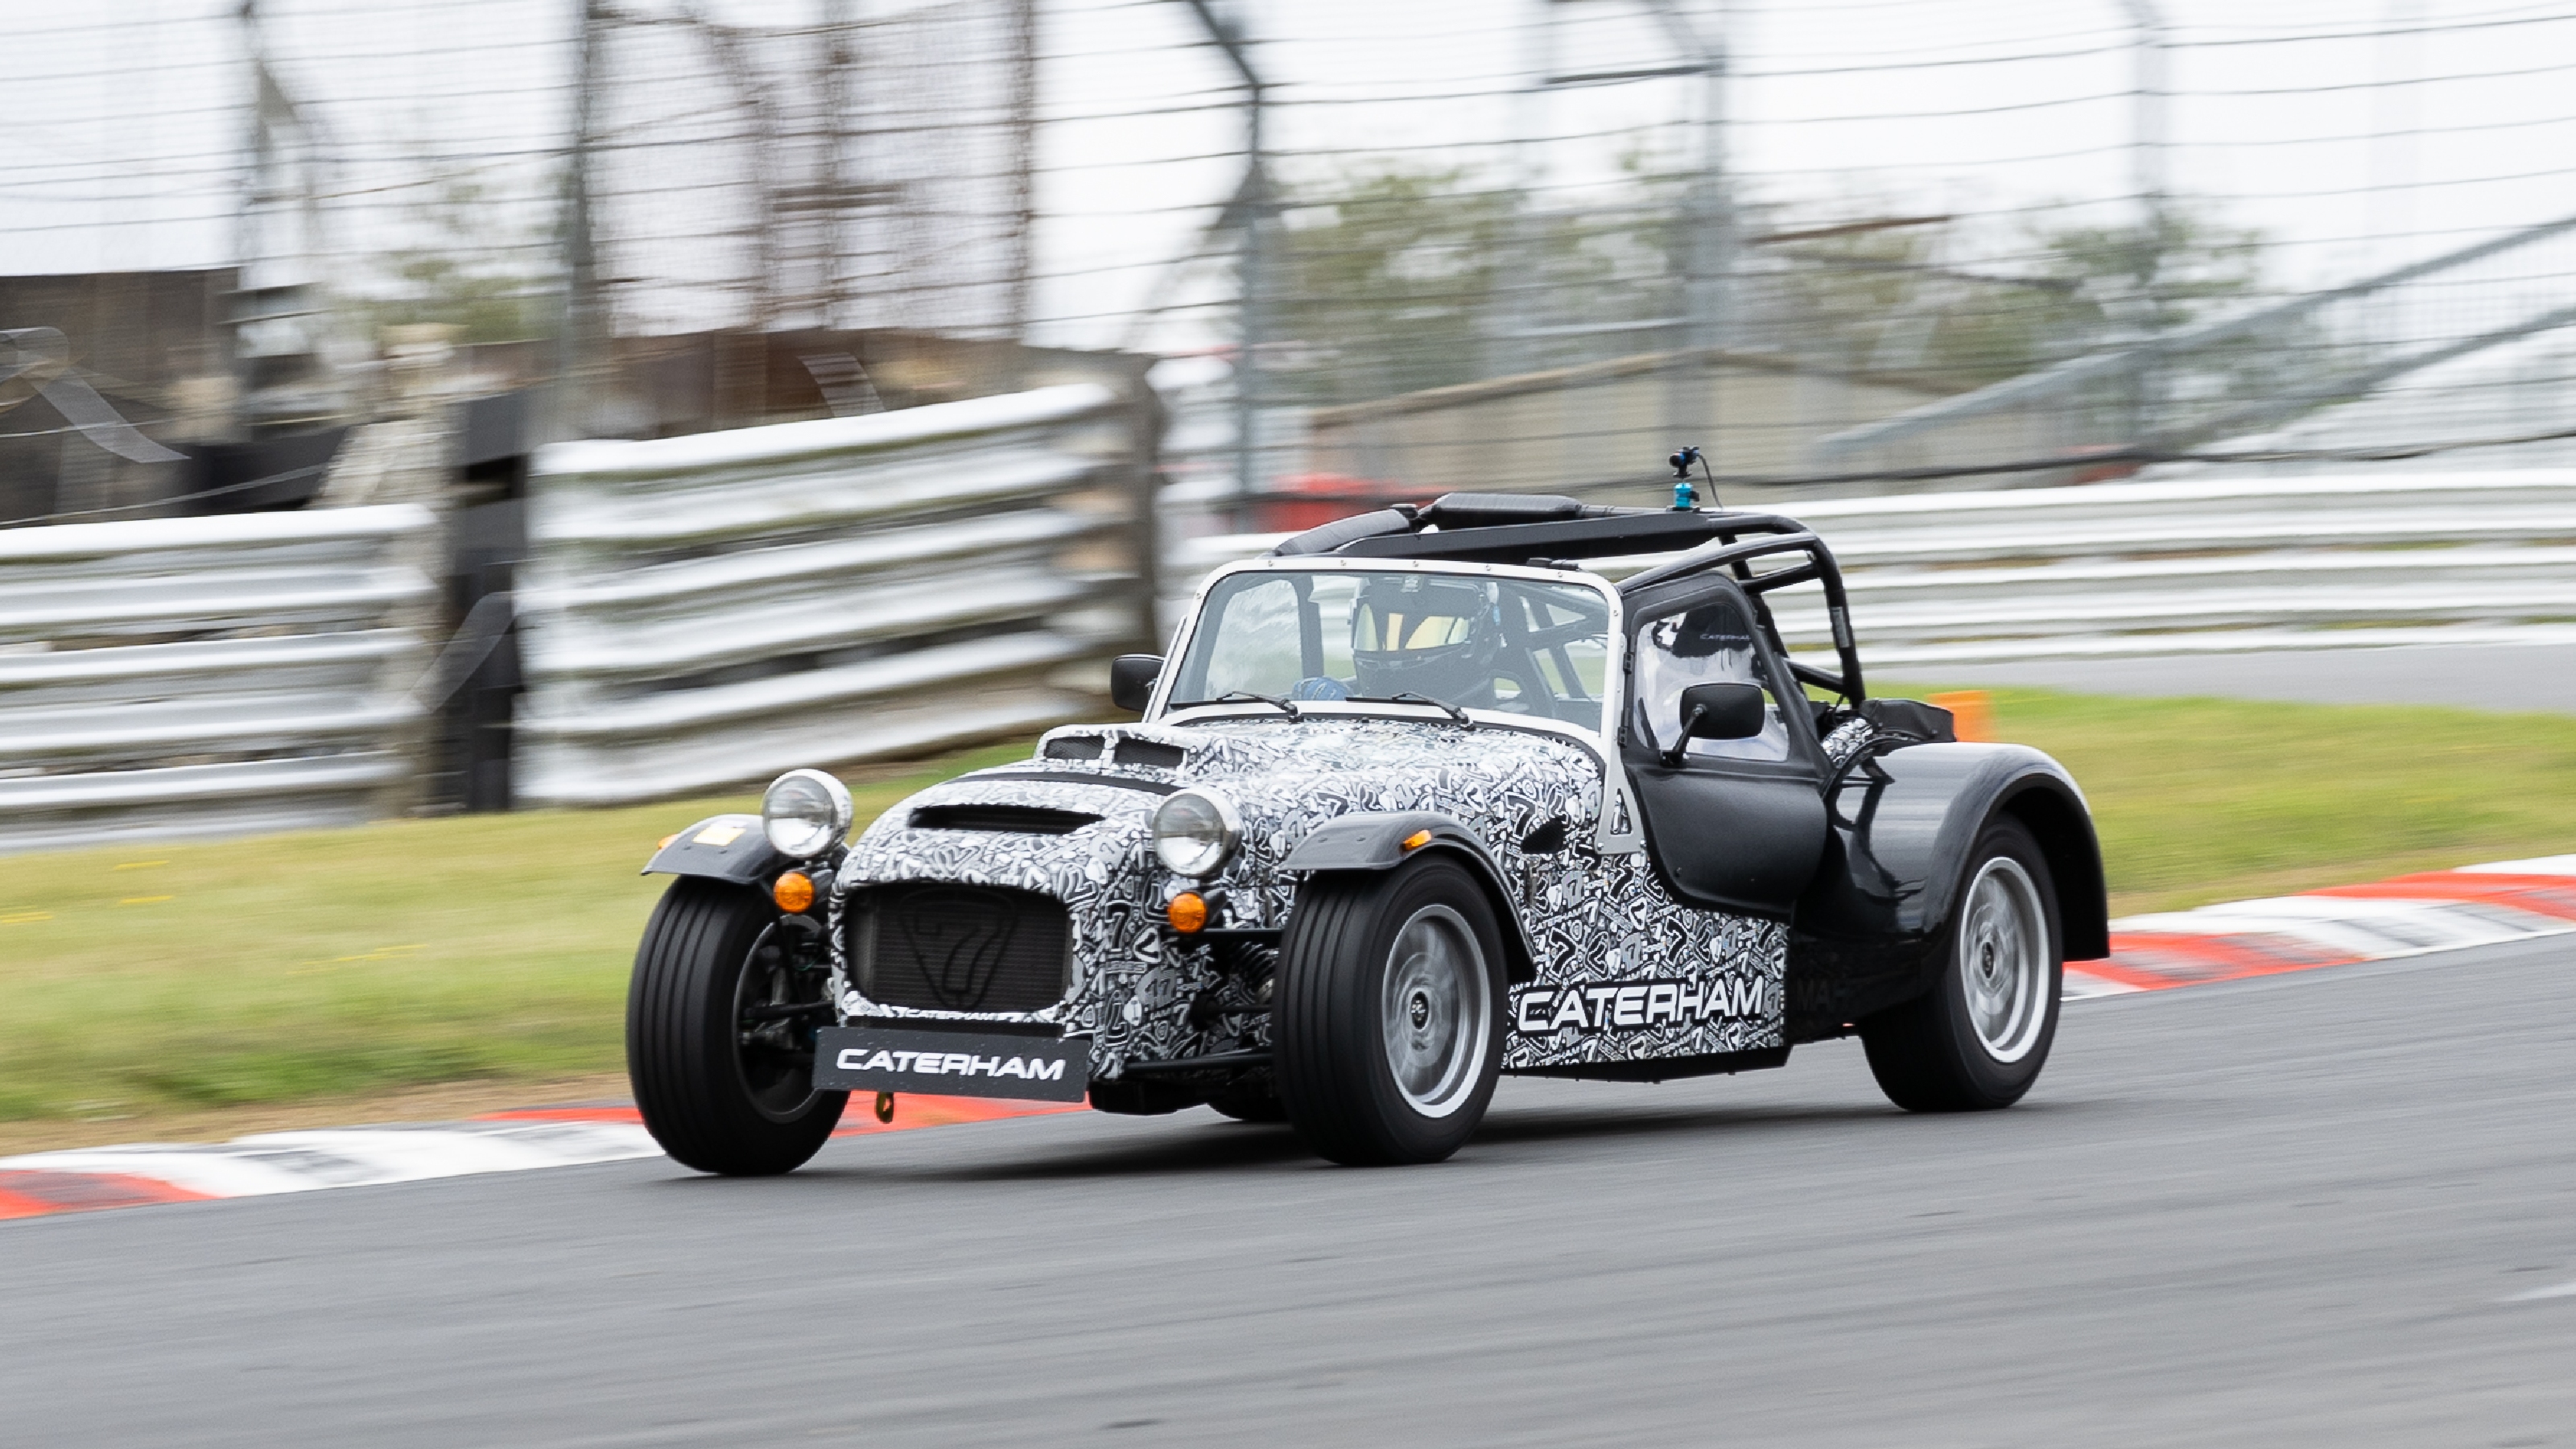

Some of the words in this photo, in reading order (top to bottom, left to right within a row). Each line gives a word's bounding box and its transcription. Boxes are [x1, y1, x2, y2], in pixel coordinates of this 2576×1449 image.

[913, 901, 1004, 993] 7
[1518, 975, 1764, 1031] CATERHAM
[836, 1048, 1067, 1081] CATERHAM
